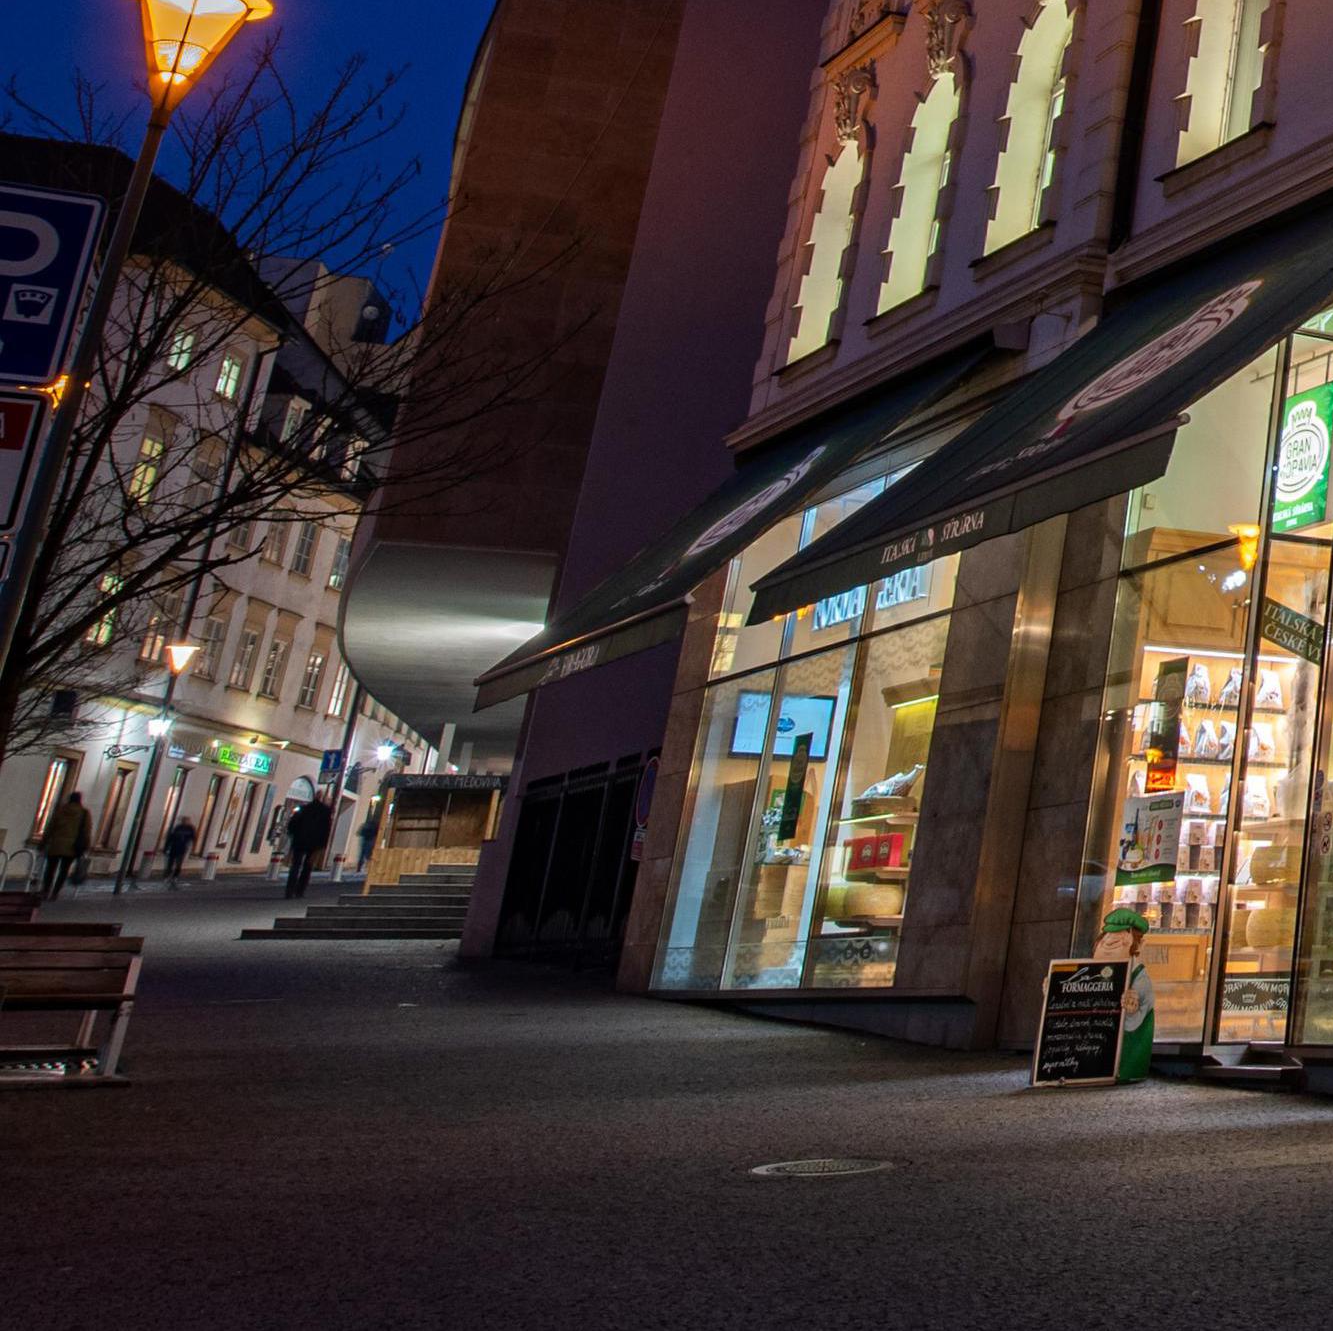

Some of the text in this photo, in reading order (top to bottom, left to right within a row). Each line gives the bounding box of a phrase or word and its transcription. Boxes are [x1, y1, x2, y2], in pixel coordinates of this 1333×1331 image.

[1286, 436, 1312, 459] GRAN
[1264, 603, 1316, 638] ITALSKÁ
[1264, 620, 1305, 656] ČESKÉ
[1062, 981, 1113, 993] FORMAGGERIA
